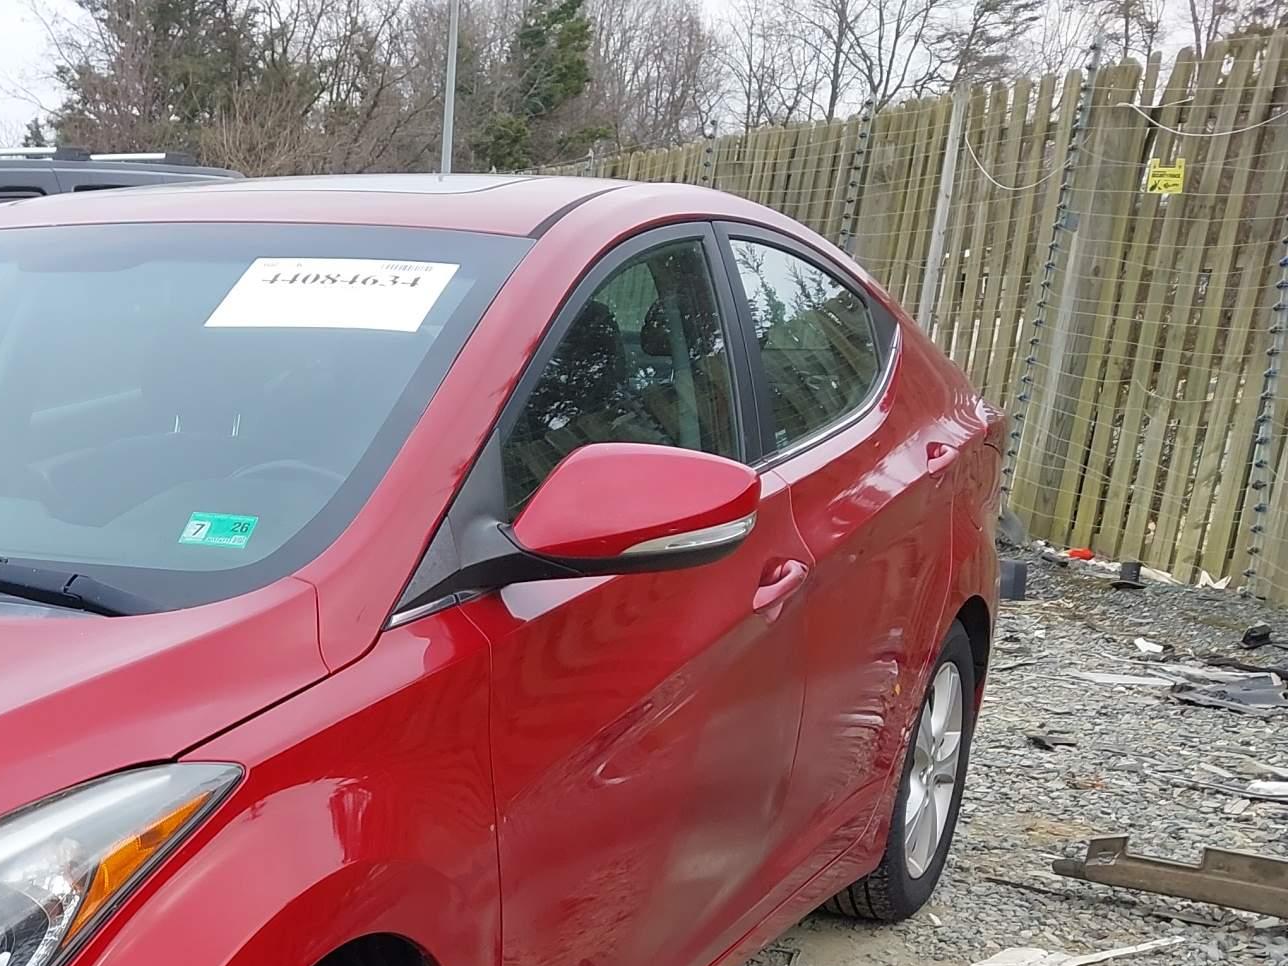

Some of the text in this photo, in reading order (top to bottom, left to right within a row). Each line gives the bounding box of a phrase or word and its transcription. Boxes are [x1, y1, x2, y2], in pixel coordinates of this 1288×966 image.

[262, 272, 421, 288] 44084634
[192, 522, 251, 537] 7 26
